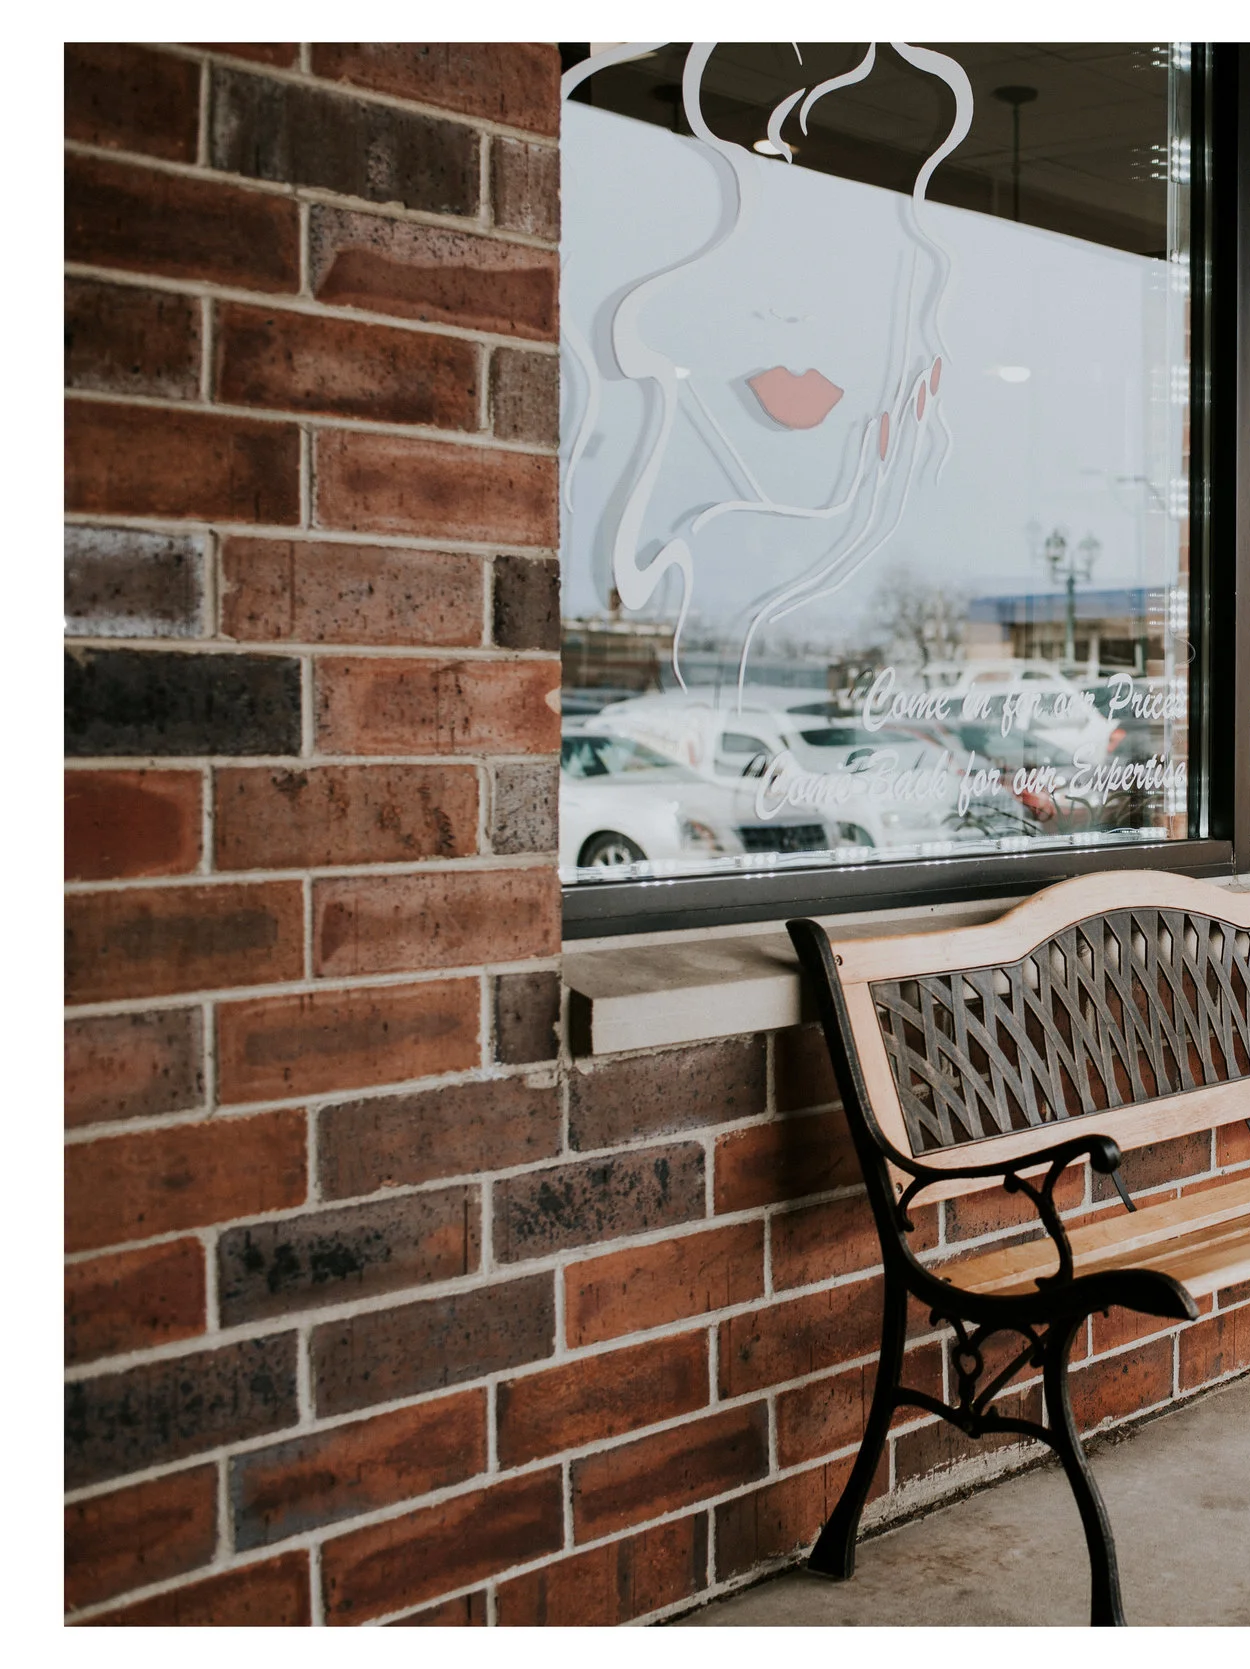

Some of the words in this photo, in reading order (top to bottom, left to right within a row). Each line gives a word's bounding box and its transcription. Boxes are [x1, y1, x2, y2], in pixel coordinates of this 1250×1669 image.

[862, 666, 951, 732] Come
[962, 683, 991, 719] in
[1000, 688, 1044, 738] for
[1054, 690, 1096, 716] our
[1106, 672, 1188, 722] Prices
[755, 748, 852, 820] Come
[858, 749, 950, 801] Back
[957, 750, 1003, 818] for
[1013, 765, 1060, 796] our
[1070, 742, 1188, 805] Expertise
